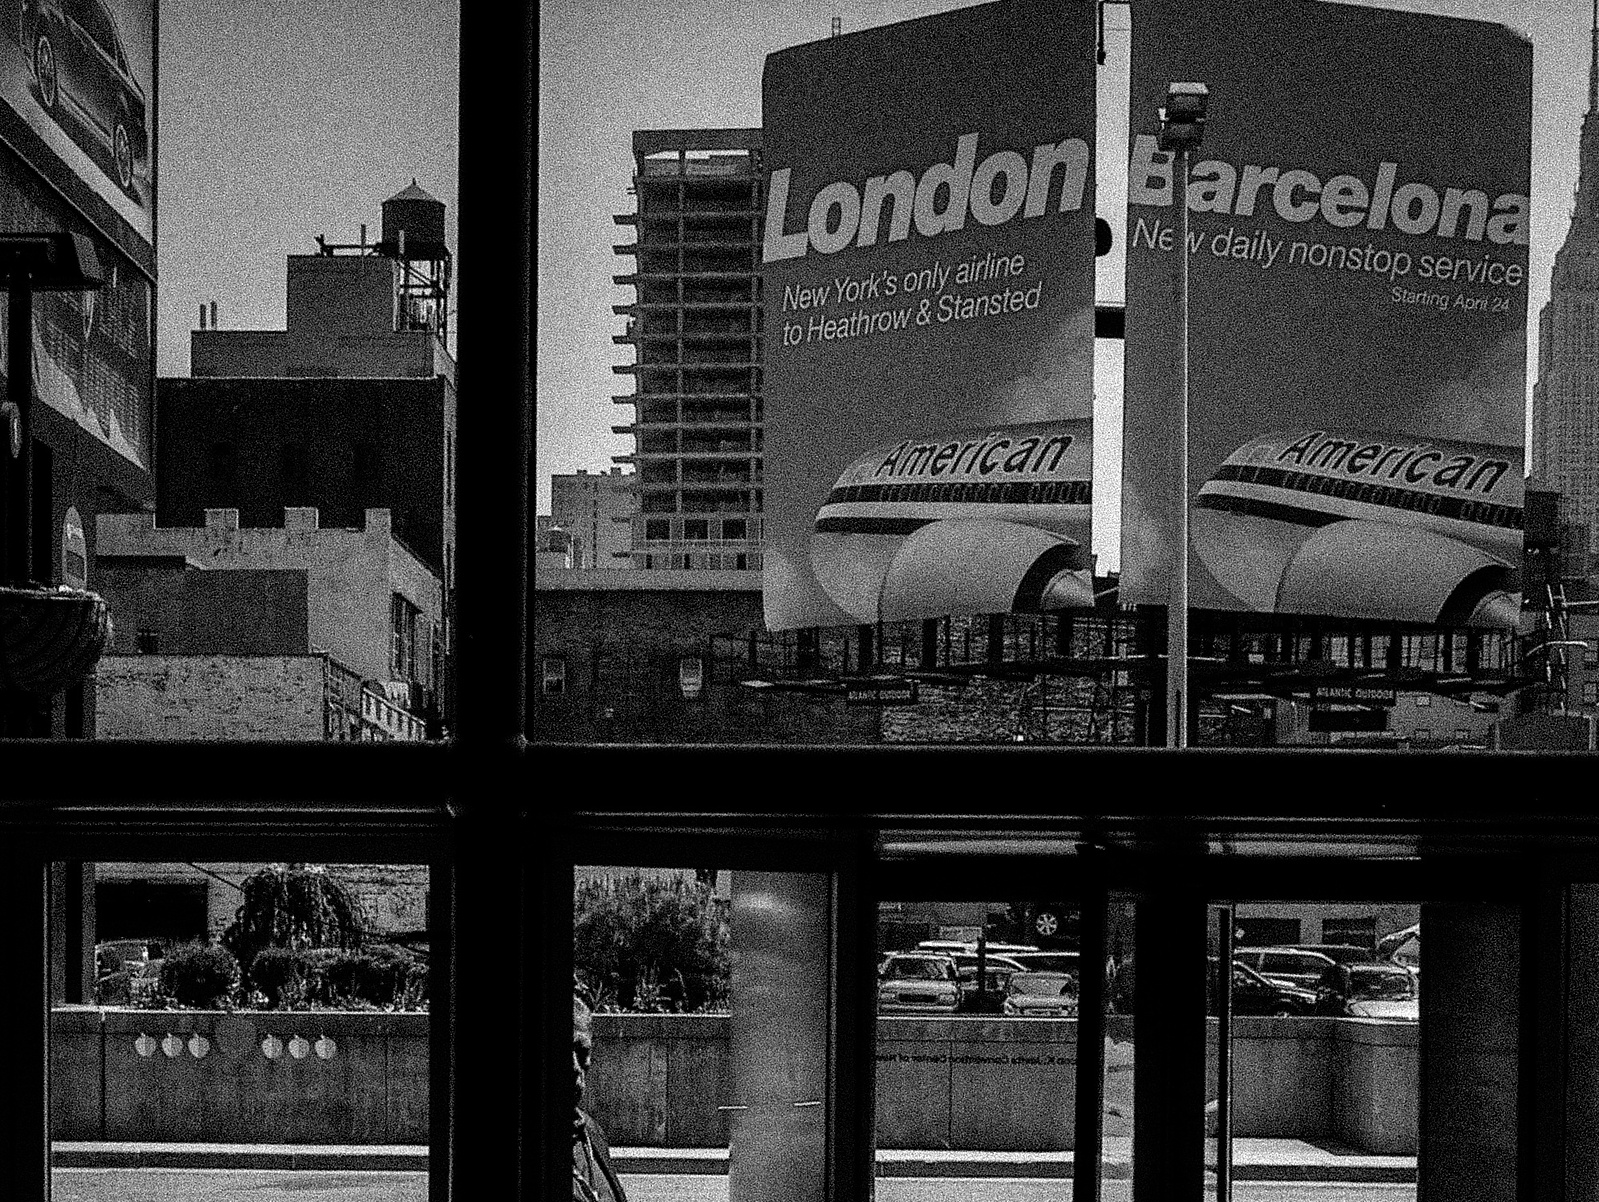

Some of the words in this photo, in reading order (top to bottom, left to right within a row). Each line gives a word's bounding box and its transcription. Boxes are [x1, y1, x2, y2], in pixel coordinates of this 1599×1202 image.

[763, 132, 1090, 263] London
[1128, 134, 1530, 245] Barcelona
[783, 284, 830, 312] New
[834, 270, 898, 303] York's
[903, 260, 951, 294] only
[956, 252, 1025, 284] airline
[1132, 218, 1205, 253] New
[1211, 227, 1284, 269] daily
[1289, 242, 1412, 282] nonstop
[1418, 254, 1523, 286] service
[783, 321, 802, 346] to
[807, 309, 912, 342] Heathrow
[916, 299, 932, 325] &
[937, 280, 1043, 322] Stansted
[1392, 286, 1450, 310] Starting
[1453, 293, 1488, 312] April
[1491, 296, 1510, 313] 24
[873, 432, 1075, 478] American
[1276, 431, 1511, 494] American
